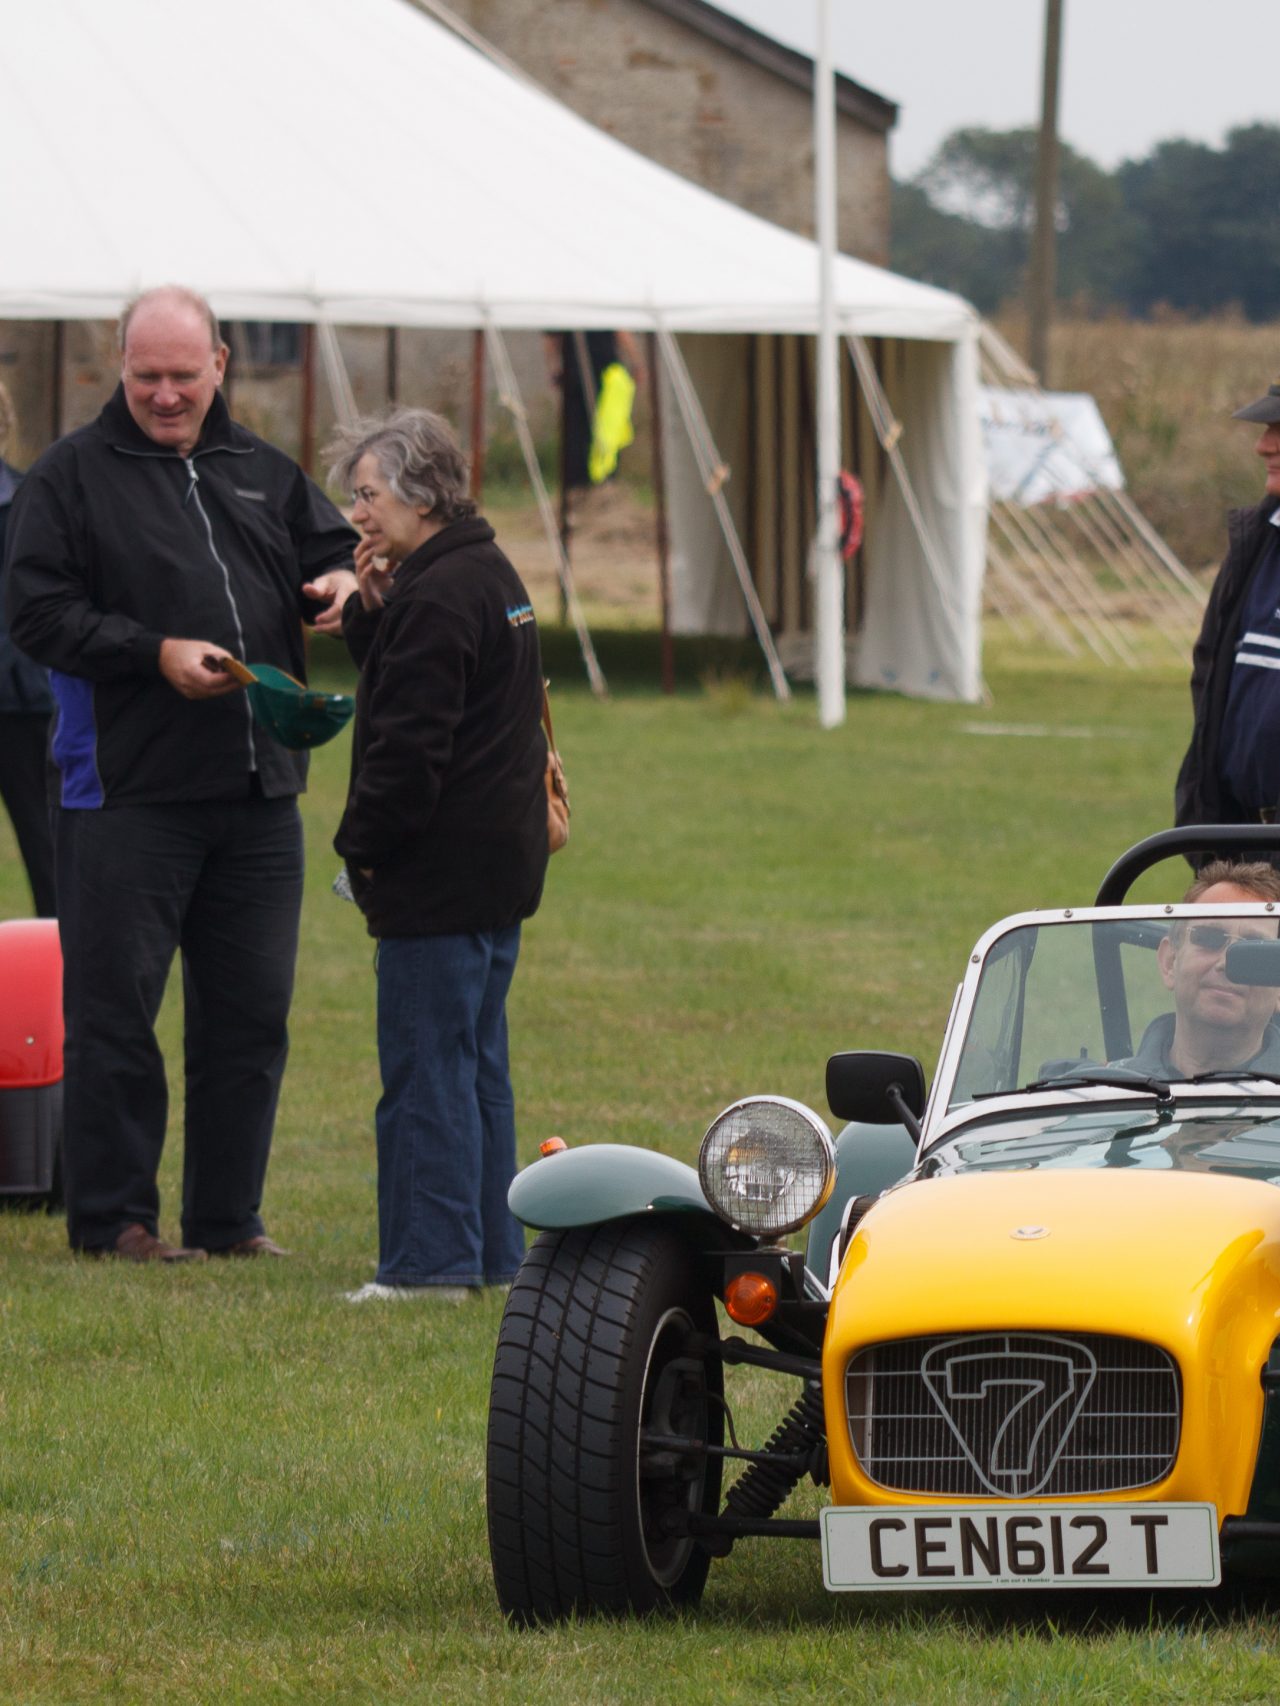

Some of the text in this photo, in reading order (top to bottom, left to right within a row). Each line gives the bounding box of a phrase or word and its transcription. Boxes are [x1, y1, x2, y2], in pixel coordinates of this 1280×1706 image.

[946, 1352, 1075, 1475] 7
[868, 1514, 1169, 1578] CEN612 T
